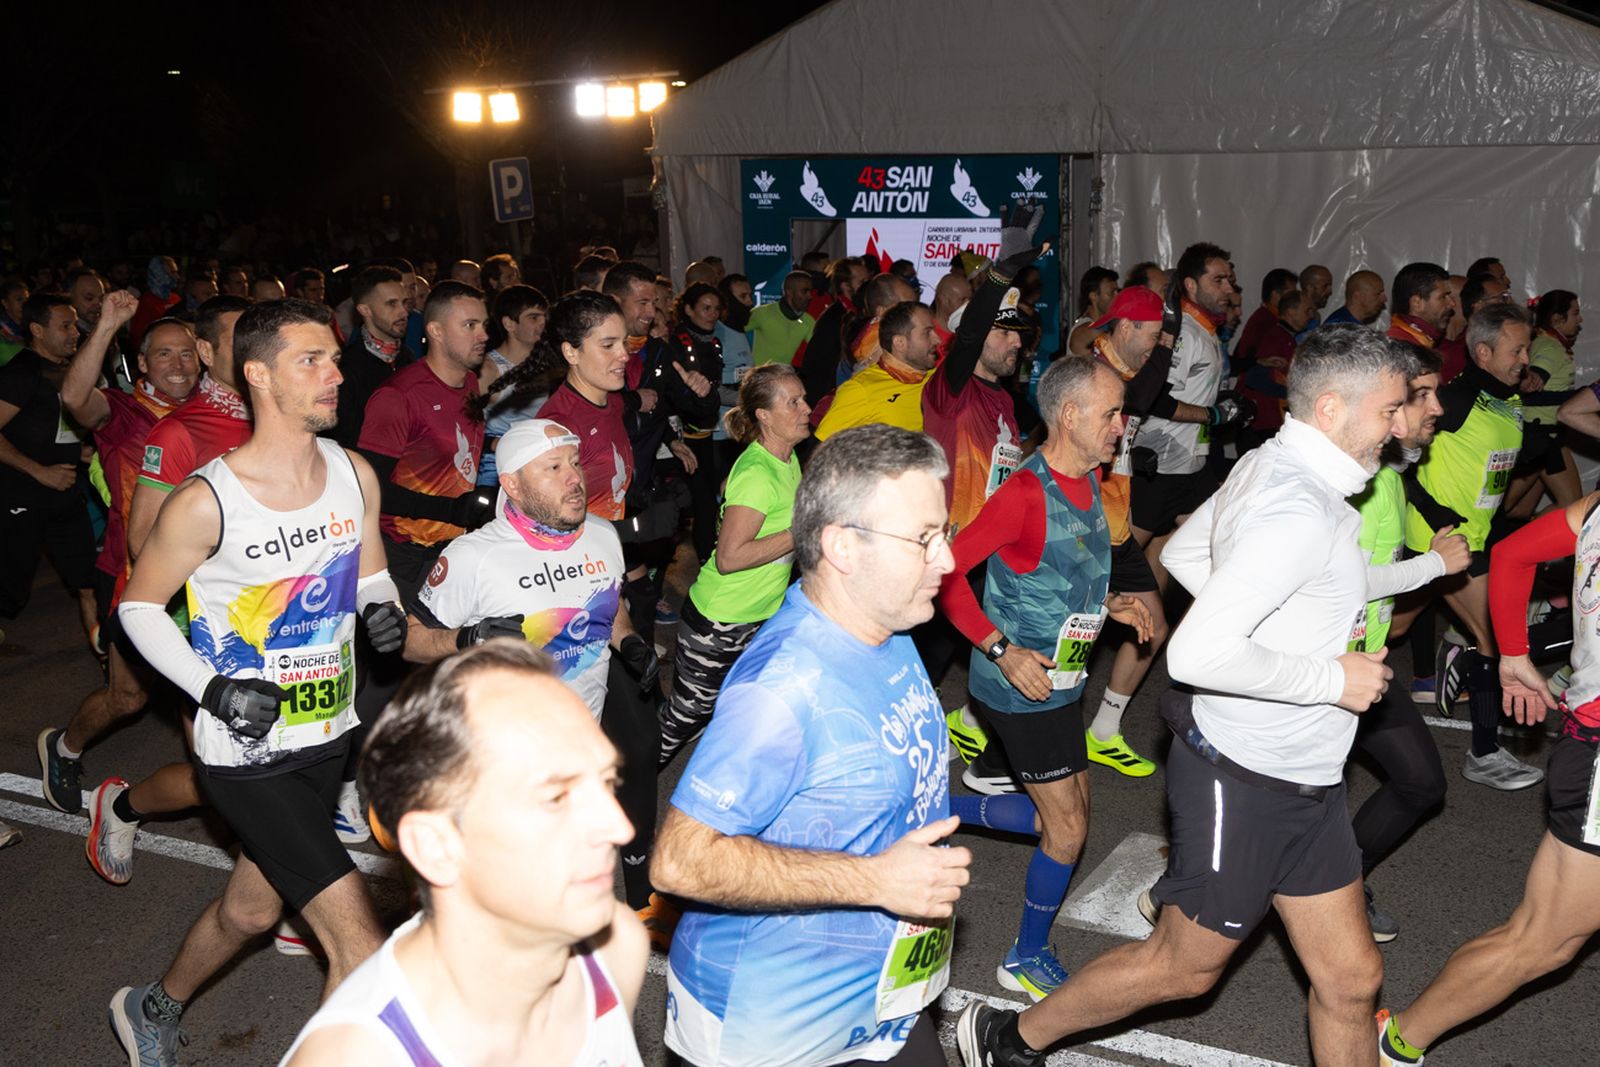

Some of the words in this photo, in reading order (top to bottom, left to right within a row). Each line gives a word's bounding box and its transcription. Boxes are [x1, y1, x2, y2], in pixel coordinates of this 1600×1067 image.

[857, 166, 885, 190] 43
[885, 166, 933, 188] SAN
[499, 167, 523, 214] P
[811, 192, 825, 208] 43
[851, 185, 929, 213] ANTÓN
[962, 192, 977, 207] 43
[924, 243, 961, 259] SAN
[1066, 630, 1082, 639] SAN
[293, 655, 328, 669] NOCHE
[328, 653, 340, 664] DE
[280, 671, 303, 683] SAN
[1035, 766, 1072, 781] LURBEL
